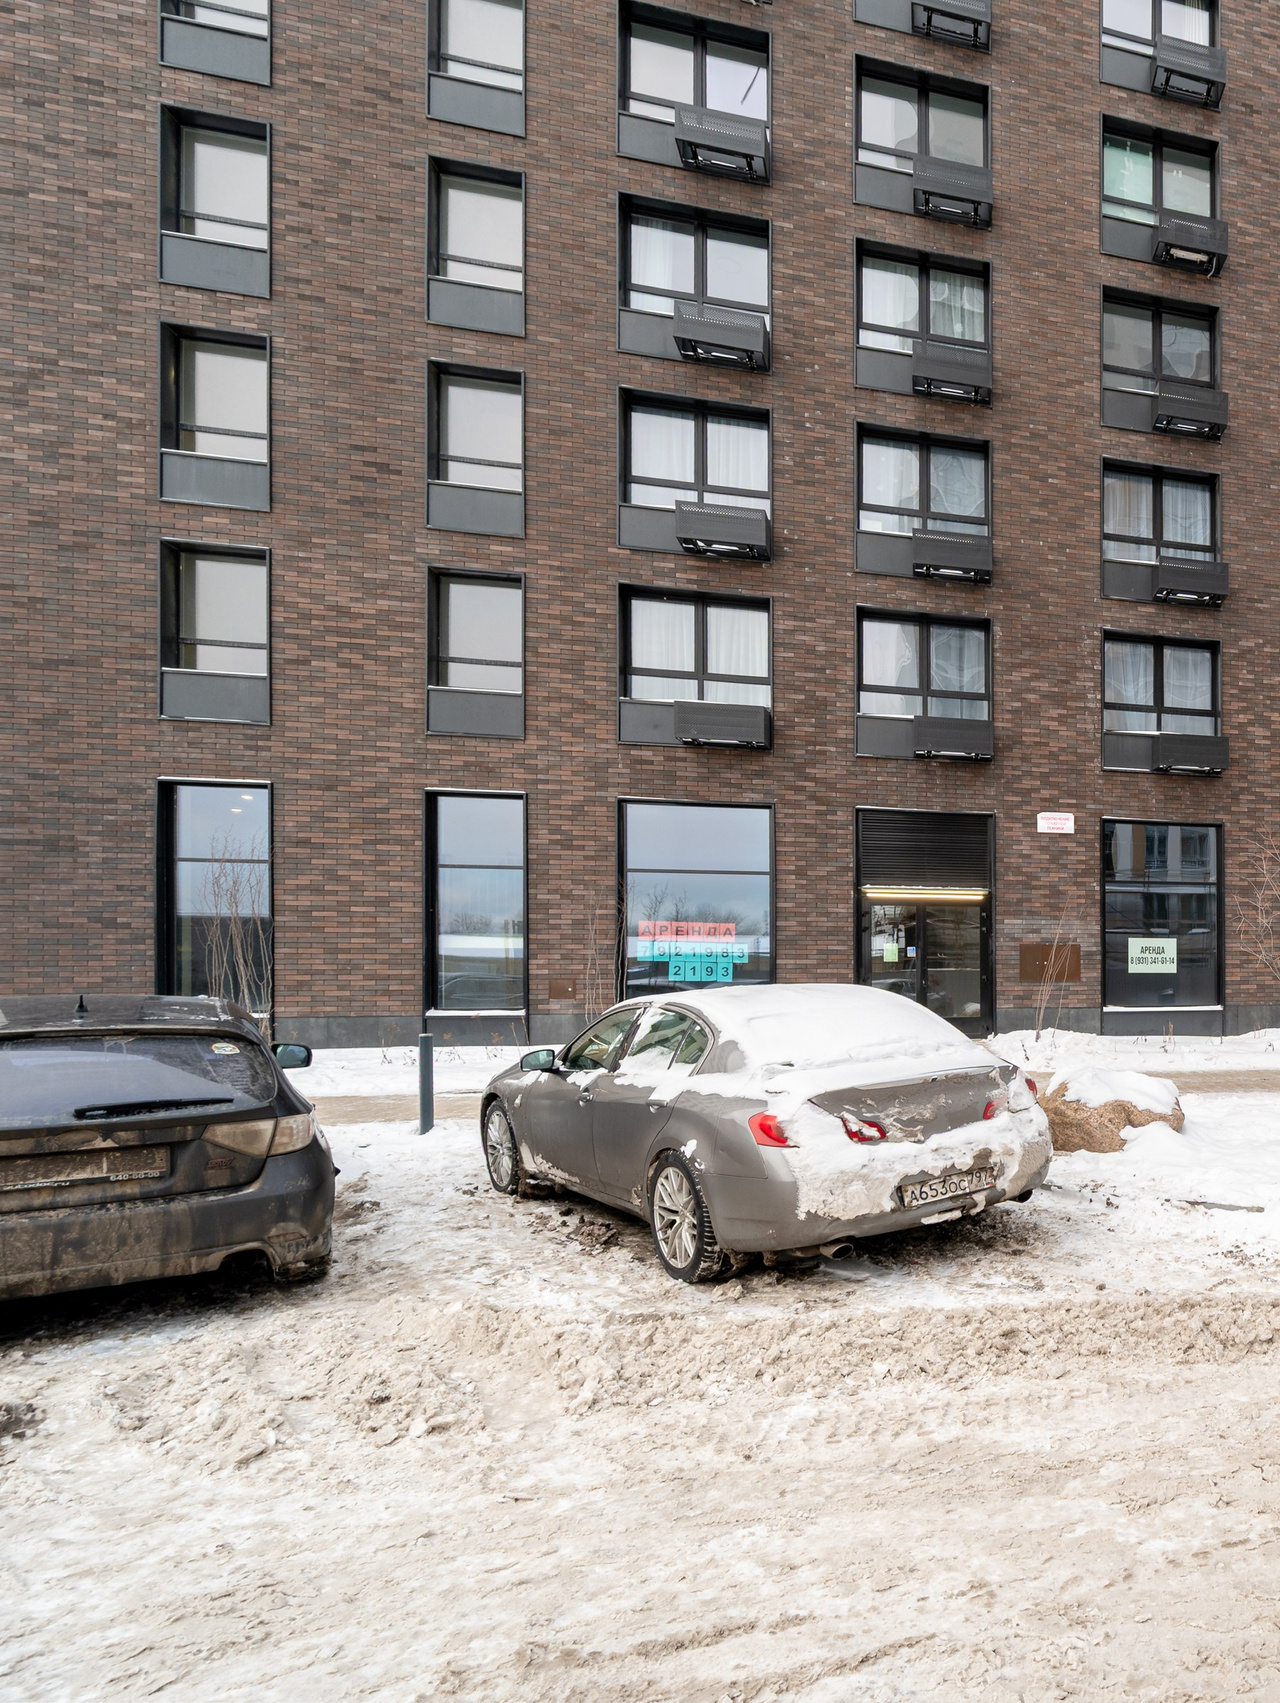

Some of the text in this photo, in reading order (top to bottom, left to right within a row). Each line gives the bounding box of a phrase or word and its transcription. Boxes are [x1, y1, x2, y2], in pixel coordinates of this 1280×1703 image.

[641, 925, 734, 939] АРЕНДА
[641, 945, 745, 959] 7921983
[1140, 946, 1166, 956] АРЕНДА
[1130, 956, 1175, 966] 8 (931) 341-61-14
[672, 965, 730, 977] 2193
